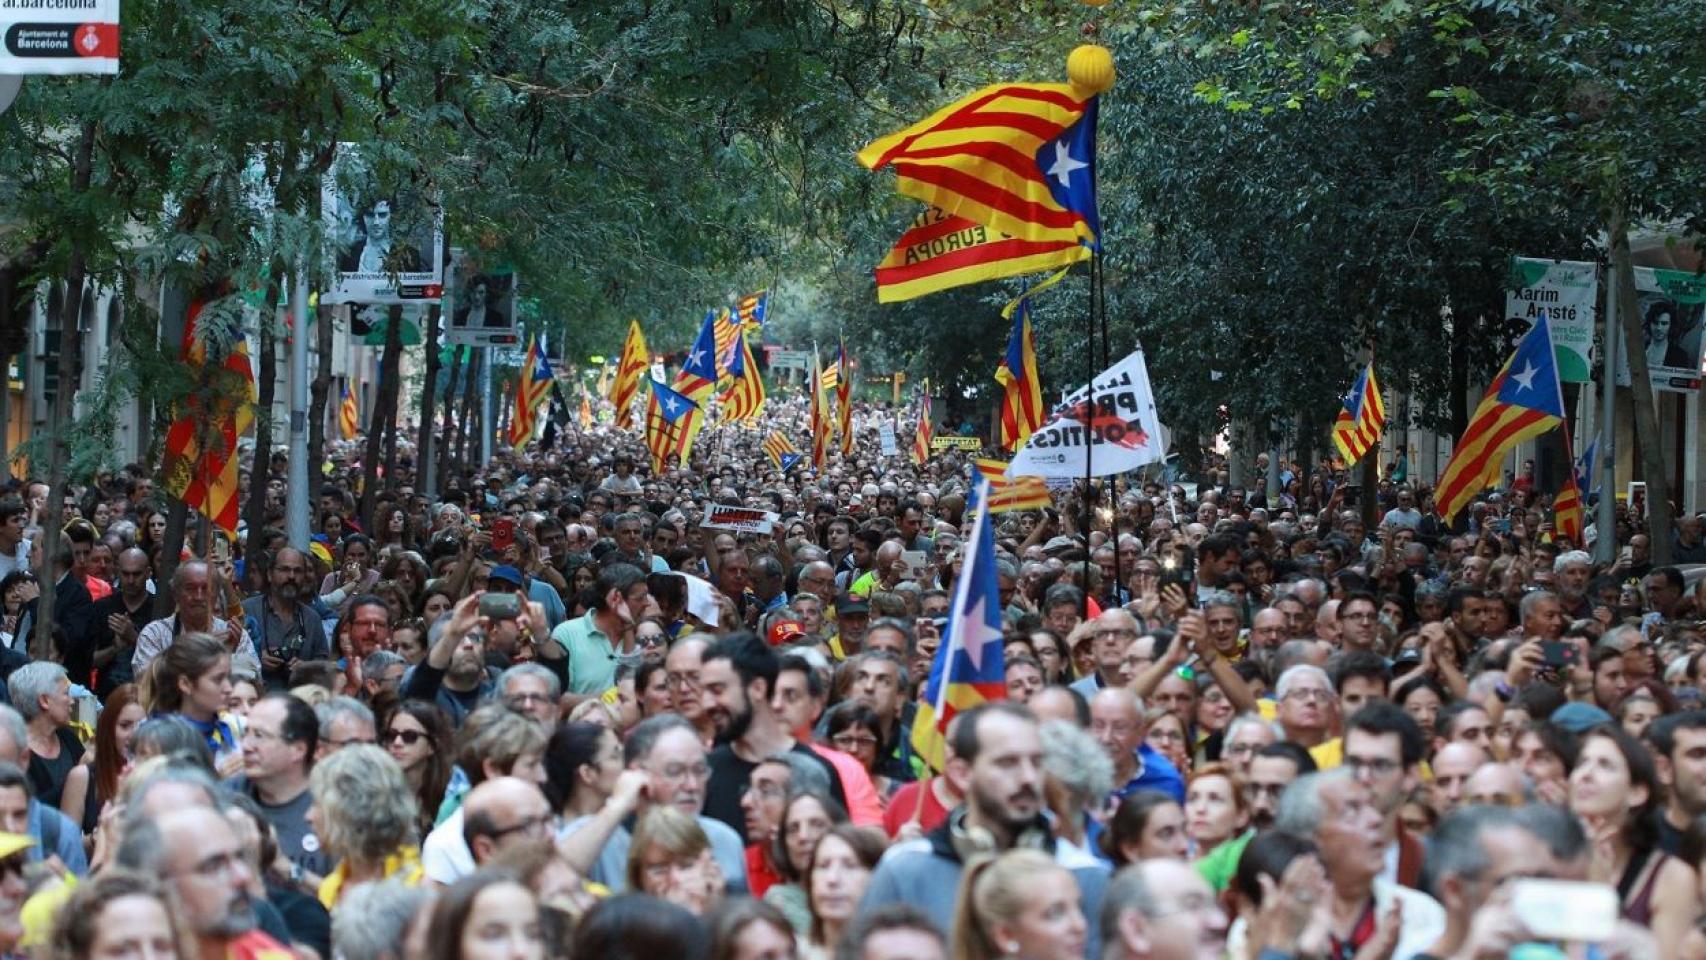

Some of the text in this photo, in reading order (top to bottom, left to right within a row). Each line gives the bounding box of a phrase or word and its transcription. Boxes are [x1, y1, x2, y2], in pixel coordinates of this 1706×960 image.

[18, 30, 58, 39] Ajuntament
[17, 38, 68, 49] Barcelona
[1514, 287, 1559, 302] Xarim
